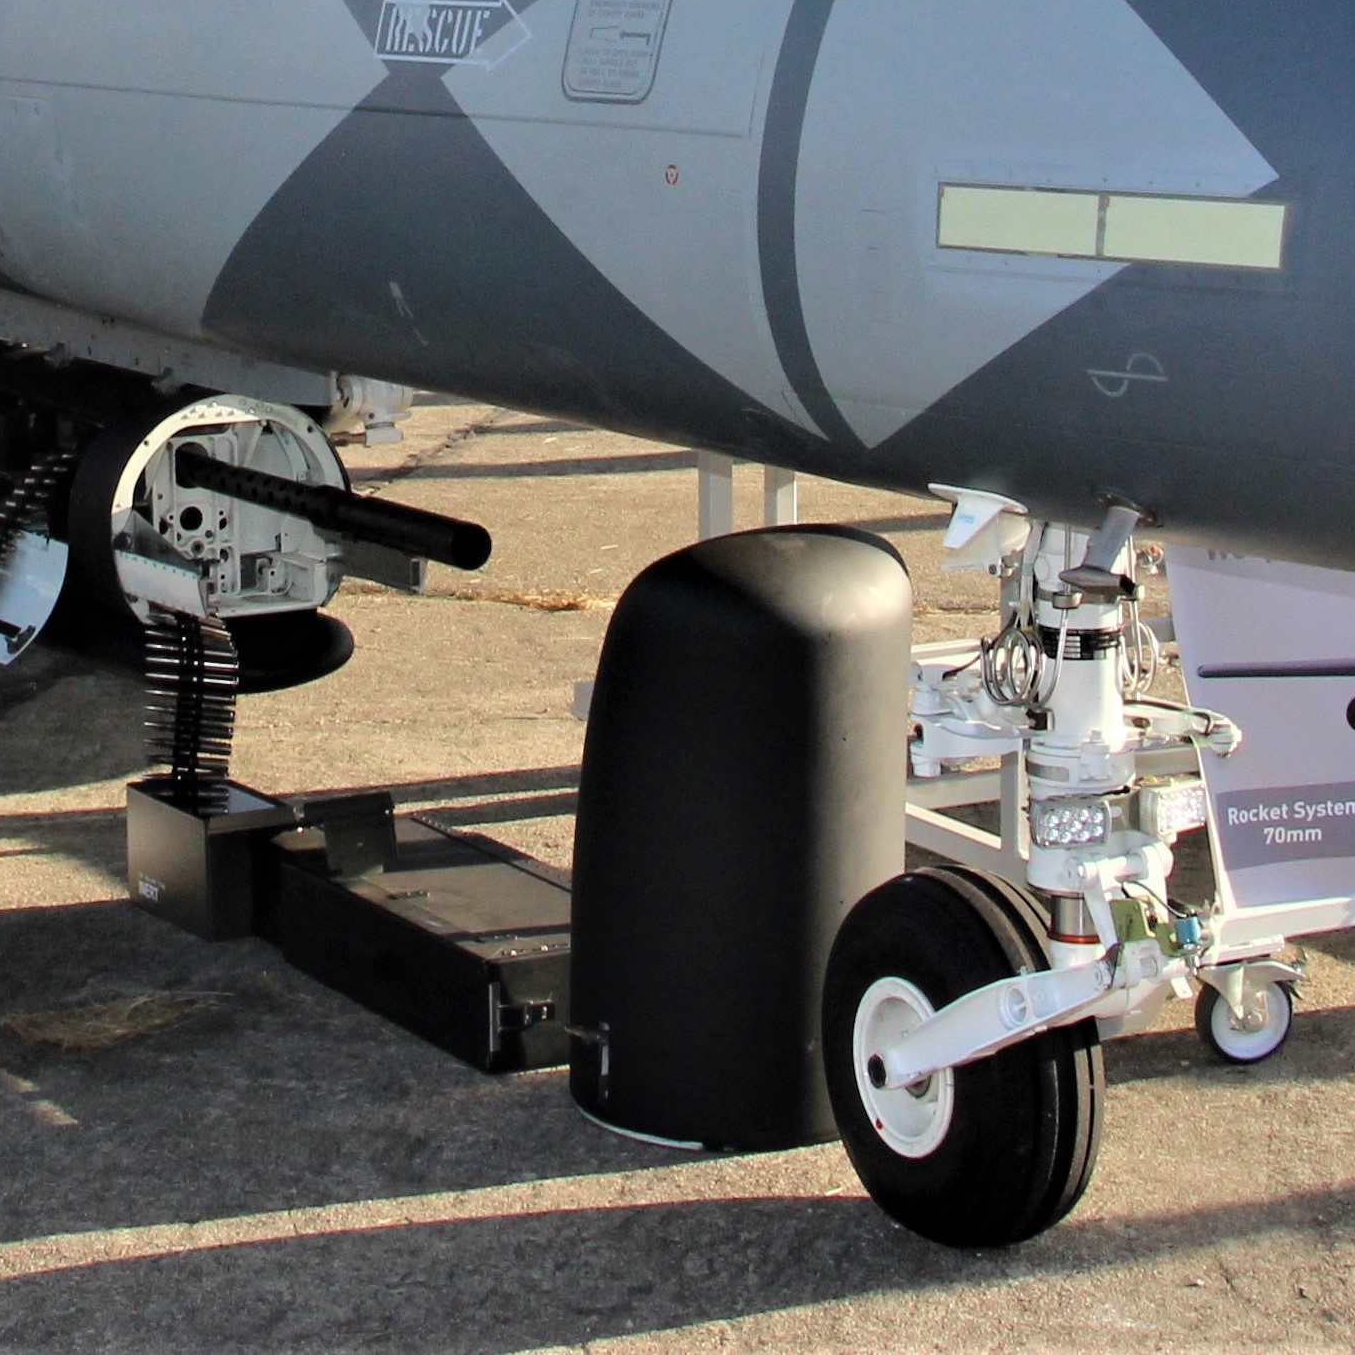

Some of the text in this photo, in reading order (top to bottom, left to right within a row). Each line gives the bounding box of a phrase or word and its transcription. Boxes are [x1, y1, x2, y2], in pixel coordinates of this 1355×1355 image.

[385, 6, 492, 55] RESCUE
[1228, 802, 1289, 825] Rocket
[1263, 825, 1323, 845] 70mm
